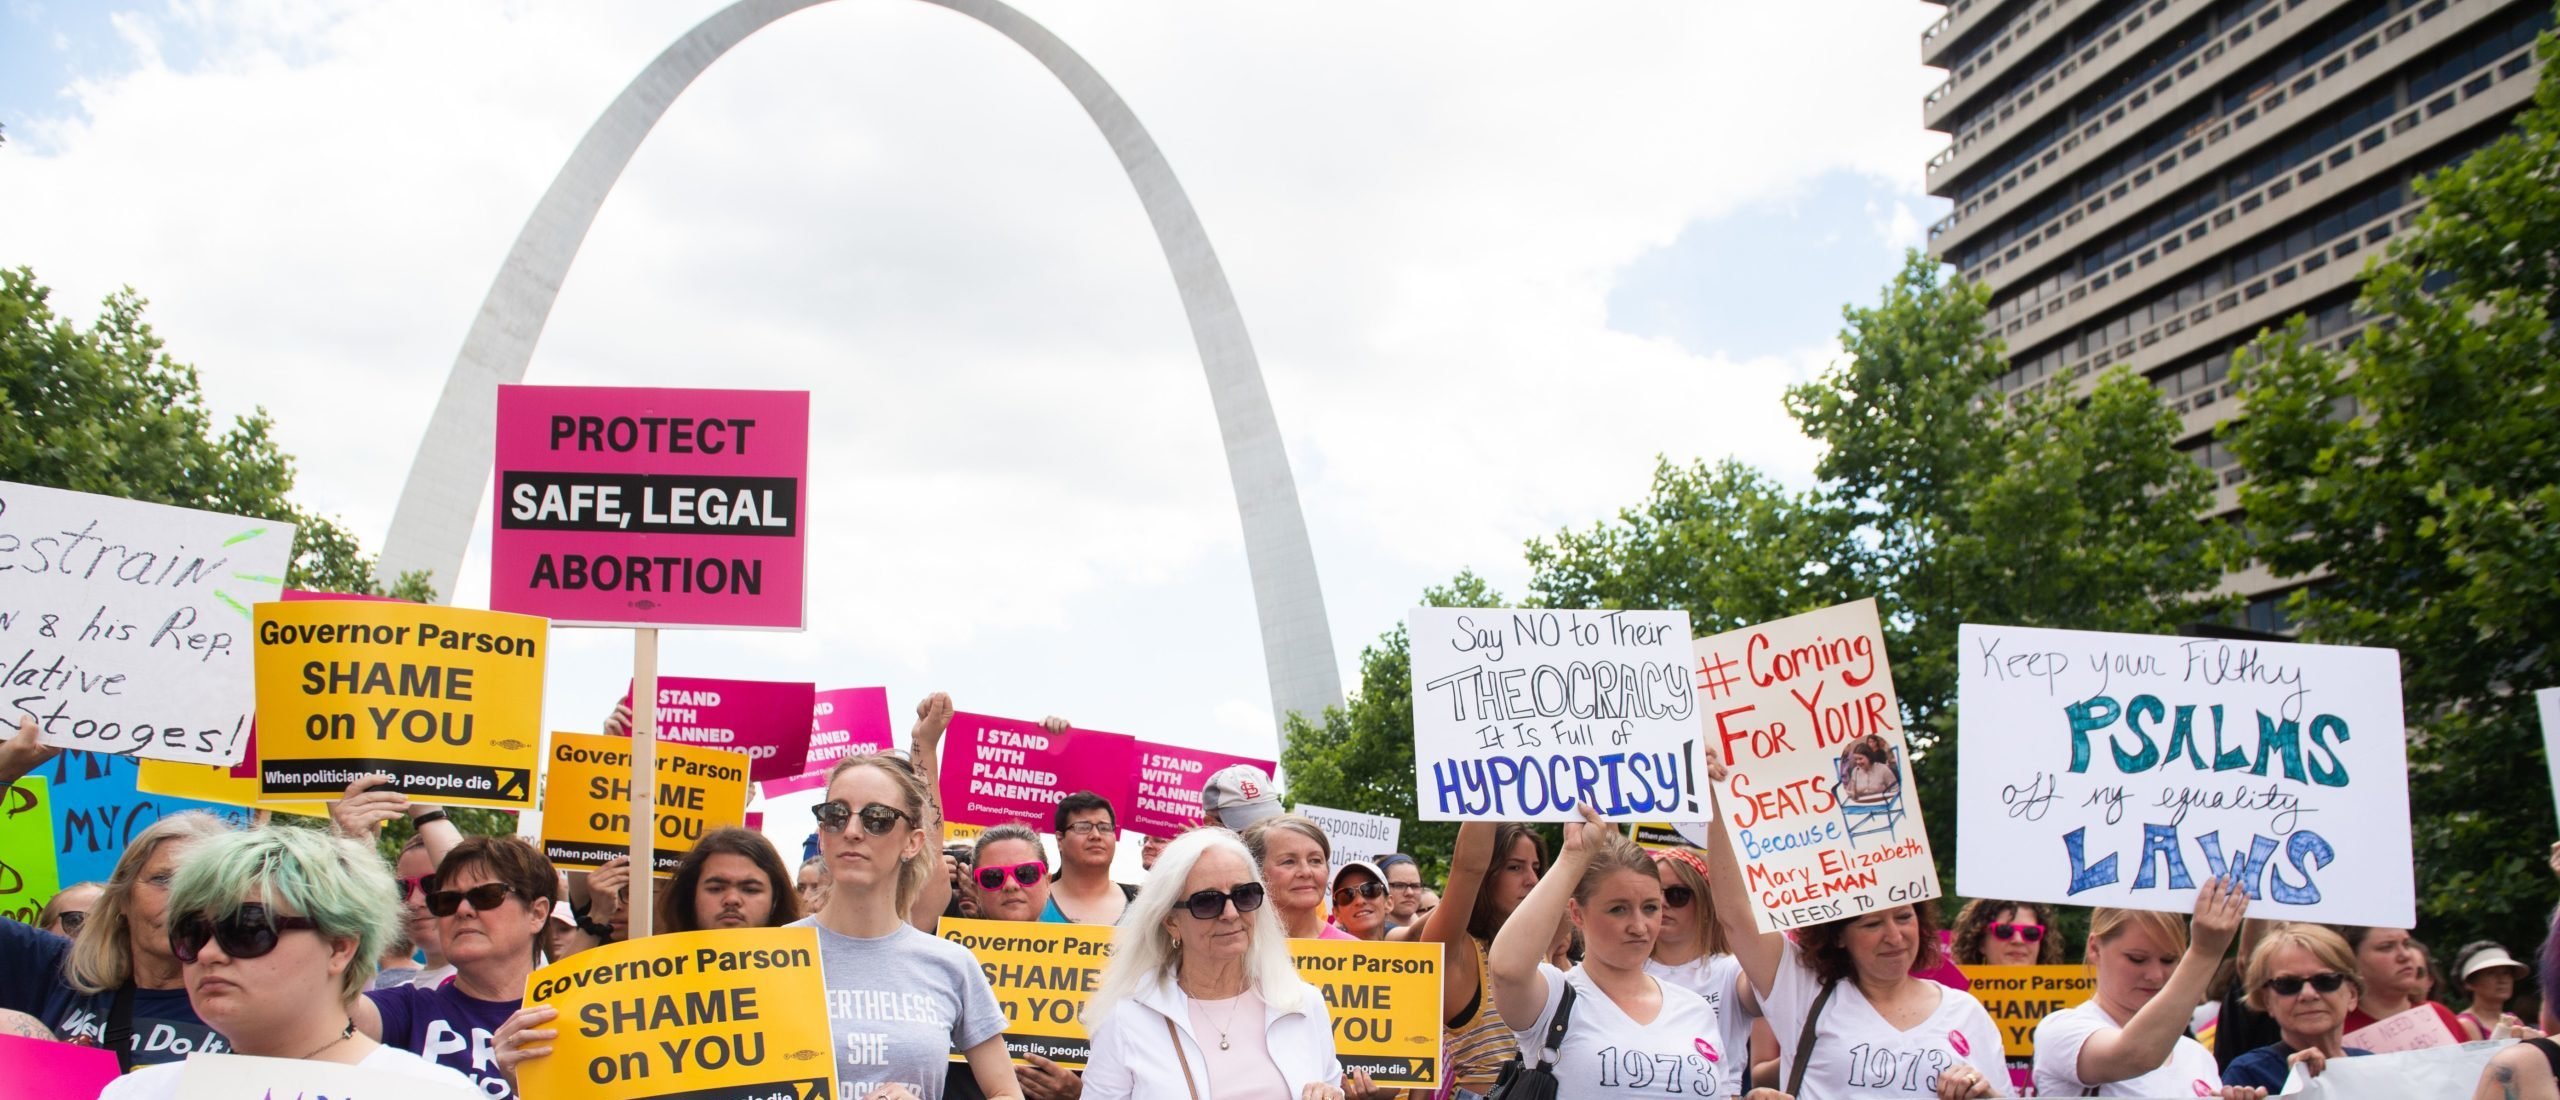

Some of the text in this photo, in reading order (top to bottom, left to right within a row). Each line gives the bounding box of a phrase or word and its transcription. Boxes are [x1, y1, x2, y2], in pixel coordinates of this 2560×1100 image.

[550, 415, 756, 455] PROTECT
[511, 483, 788, 529] SAFE, LEGAL
[0, 519, 227, 588] estrain
[529, 553, 762, 596] ABORTION
[39, 614, 59, 638] &
[78, 605, 137, 642] his
[150, 606, 232, 662] Rep.
[260, 620, 535, 658] Governor Parson
[1452, 610, 1672, 661] Say NO to Their
[301, 660, 474, 702] SHAME
[1426, 660, 1694, 721] THEOCRACY
[1978, 637, 2311, 722] Keep your Filthy
[659, 689, 721, 707] STAND
[1790, 680, 1894, 749] YOUR
[0, 695, 245, 757] Stooges!
[306, 706, 474, 746] on YOU
[657, 726, 734, 743] LANNED
[810, 729, 851, 748] NNED
[977, 727, 1049, 751] I STAND
[1475, 720, 1634, 750] It Is Full of
[2063, 693, 2351, 787] PSALMS
[672, 757, 742, 782] Parson
[807, 742, 877, 763] RENTHOOD
[976, 744, 1025, 766] WITH
[1142, 753, 1203, 774] I STAND
[265, 771, 300, 785] When
[403, 773, 463, 790] people
[466, 776, 491, 790] die
[972, 762, 1058, 787] PLANNED
[1141, 767, 1182, 786] WITH
[1432, 739, 1699, 816] HYPOCRISY!
[589, 776, 705, 811] SHME
[969, 779, 1072, 806] PARENTHO
[1136, 796, 1205, 819] PARENTH
[1138, 782, 1203, 804] PLANNE
[1730, 773, 1836, 829] SEATS
[2002, 772, 2064, 822] off
[2152, 784, 2319, 835] equality
[589, 812, 630, 832] on
[975, 804, 1043, 820] Planned Parenthood
[953, 828, 968, 838] on
[1739, 821, 1842, 860] Because
[547, 847, 580, 859] When
[1746, 837, 1924, 893] Mary Elizabeth
[2062, 823, 2336, 906] LAWS
[1762, 867, 1878, 909] COLEMAN
[1768, 875, 1930, 930] NEEDS TO GO!
[945, 930, 1117, 957] Governor Pars
[532, 948, 811, 1002] Governor Parson
[980, 962, 1102, 992] SHAME
[1352, 953, 1434, 975] Parson
[579, 987, 759, 1038] SHAME
[828, 989, 945, 1028] ERTHELESS,
[1000, 1000, 1018, 1021] n
[1321, 983, 1392, 1010] AME
[1984, 1000, 2066, 1019] HAME
[144, 1023, 192, 1055] Do
[847, 1032, 889, 1065] SHE
[1030, 1043, 1048, 1056] lie,
[1050, 1046, 1091, 1058] people
[588, 1031, 765, 1084] on YOU
[1388, 1064, 1407, 1075] die
[1597, 1046, 1717, 1097] 1973
[1848, 1043, 1953, 1093] 1973
